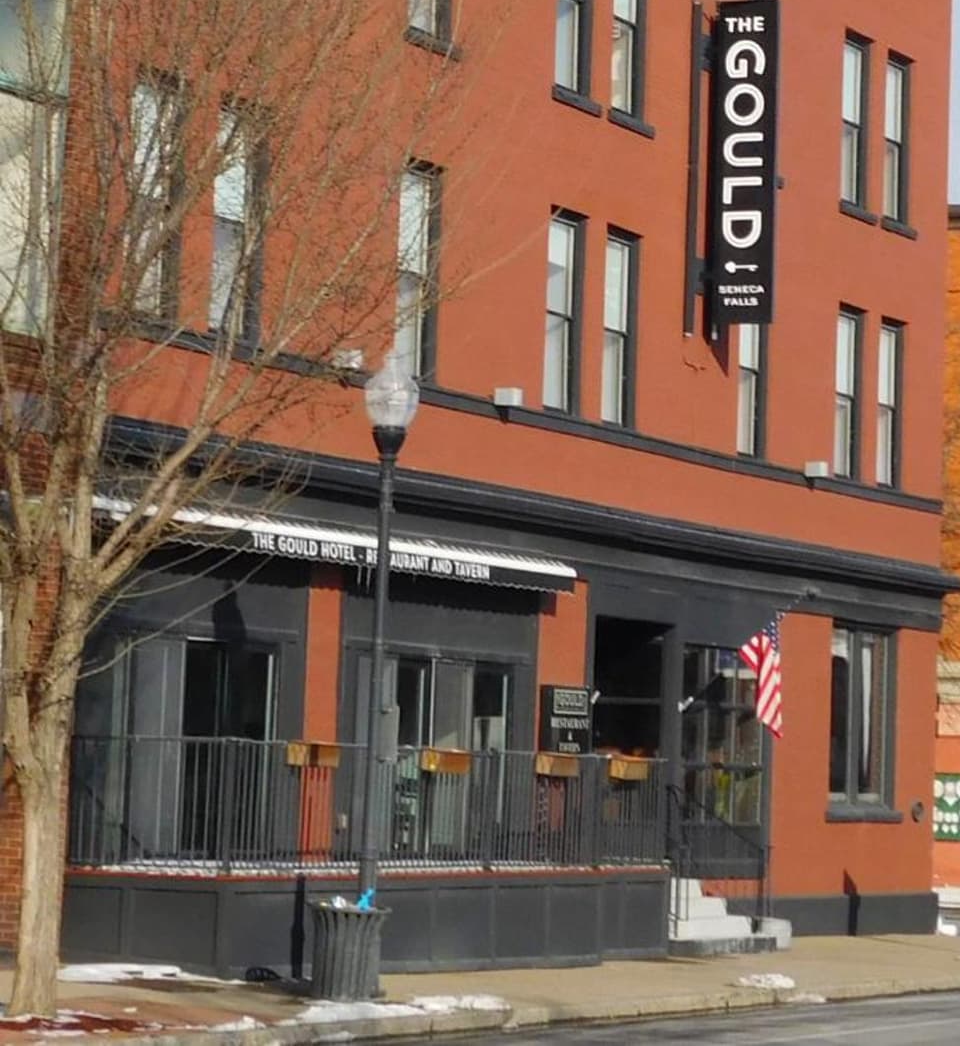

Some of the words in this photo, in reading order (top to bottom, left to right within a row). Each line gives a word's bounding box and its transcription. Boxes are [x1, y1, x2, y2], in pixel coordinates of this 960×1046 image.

[725, 16, 764, 32] THE
[722, 40, 766, 248] GOULD
[718, 285, 765, 294] SENECA
[723, 297, 759, 306] FALLS
[252, 532, 275, 550] THE
[278, 537, 319, 556] GOULD
[320, 542, 356, 561] HOTEL
[366, 547, 430, 571] REAURANT
[431, 558, 453, 574] AND
[454, 561, 490, 580] TAVERN
